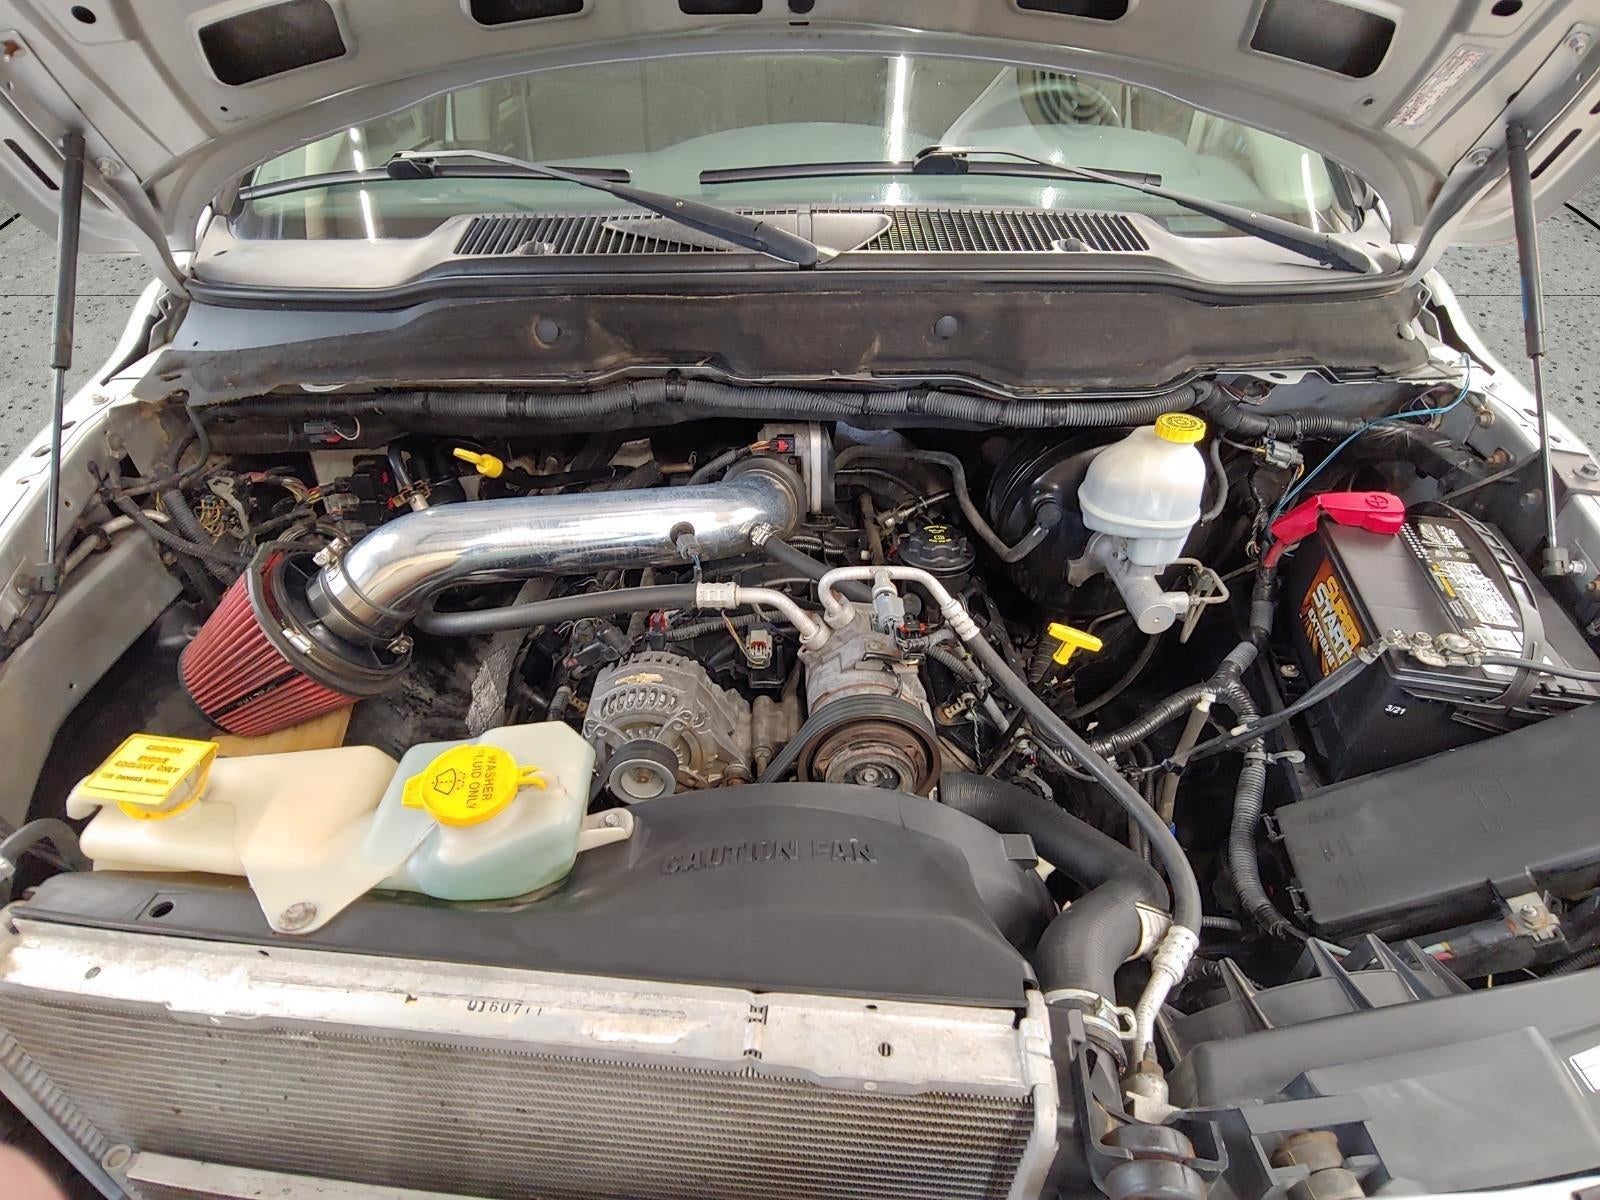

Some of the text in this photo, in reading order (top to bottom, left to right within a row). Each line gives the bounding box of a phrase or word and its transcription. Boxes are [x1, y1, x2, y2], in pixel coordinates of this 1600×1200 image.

[1312, 582, 1352, 665] START
[1326, 575, 1360, 651] SUPER
[1308, 608, 1335, 668] EXTREME
[1385, 704, 1406, 715] 3/21
[466, 782, 480, 808] ONLY
[481, 754, 496, 801] WASHER
[660, 838, 878, 876] CAUTION FAN
